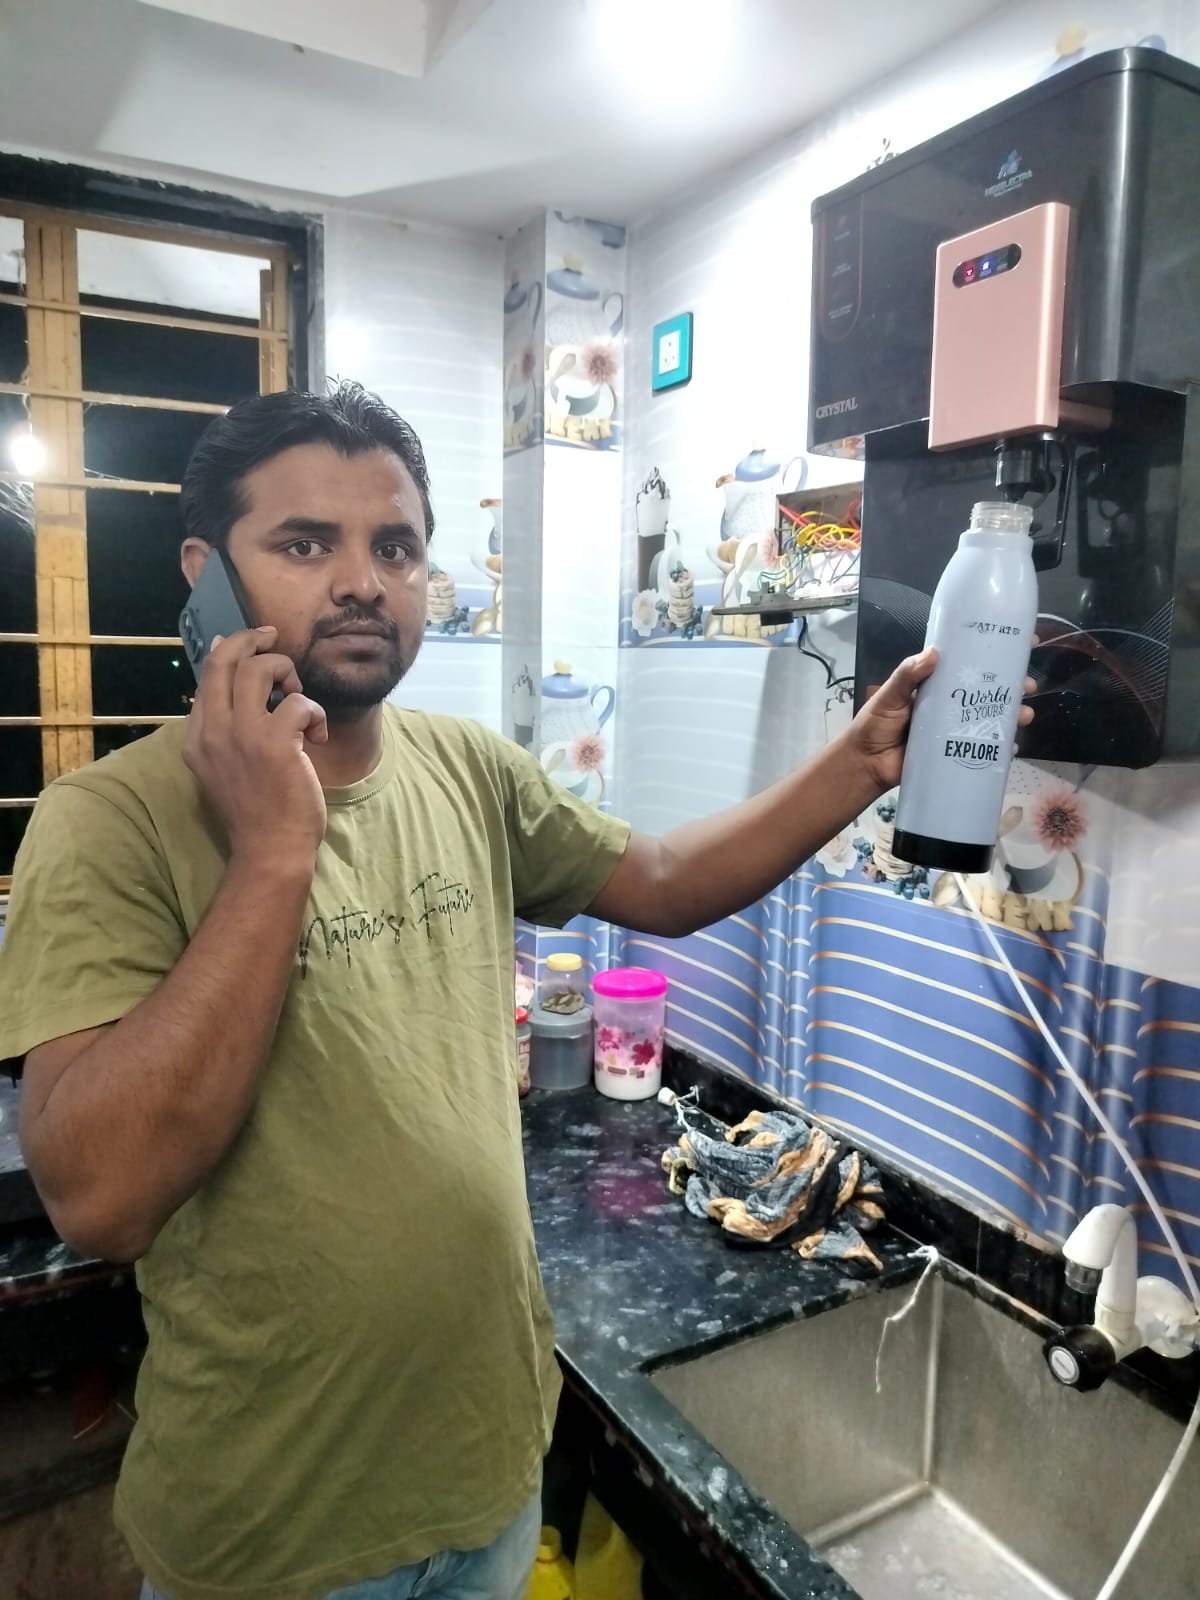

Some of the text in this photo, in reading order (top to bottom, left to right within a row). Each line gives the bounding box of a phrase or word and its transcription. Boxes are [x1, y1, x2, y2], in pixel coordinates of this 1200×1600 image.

[815, 397, 858, 419] CRYSTAL
[983, 673, 997, 682] THE
[951, 686, 1012, 708] World
[961, 703, 1005, 723] IS YOURS
[944, 740, 1000, 762] EXPLORE
[299, 905, 405, 980] Nature's
